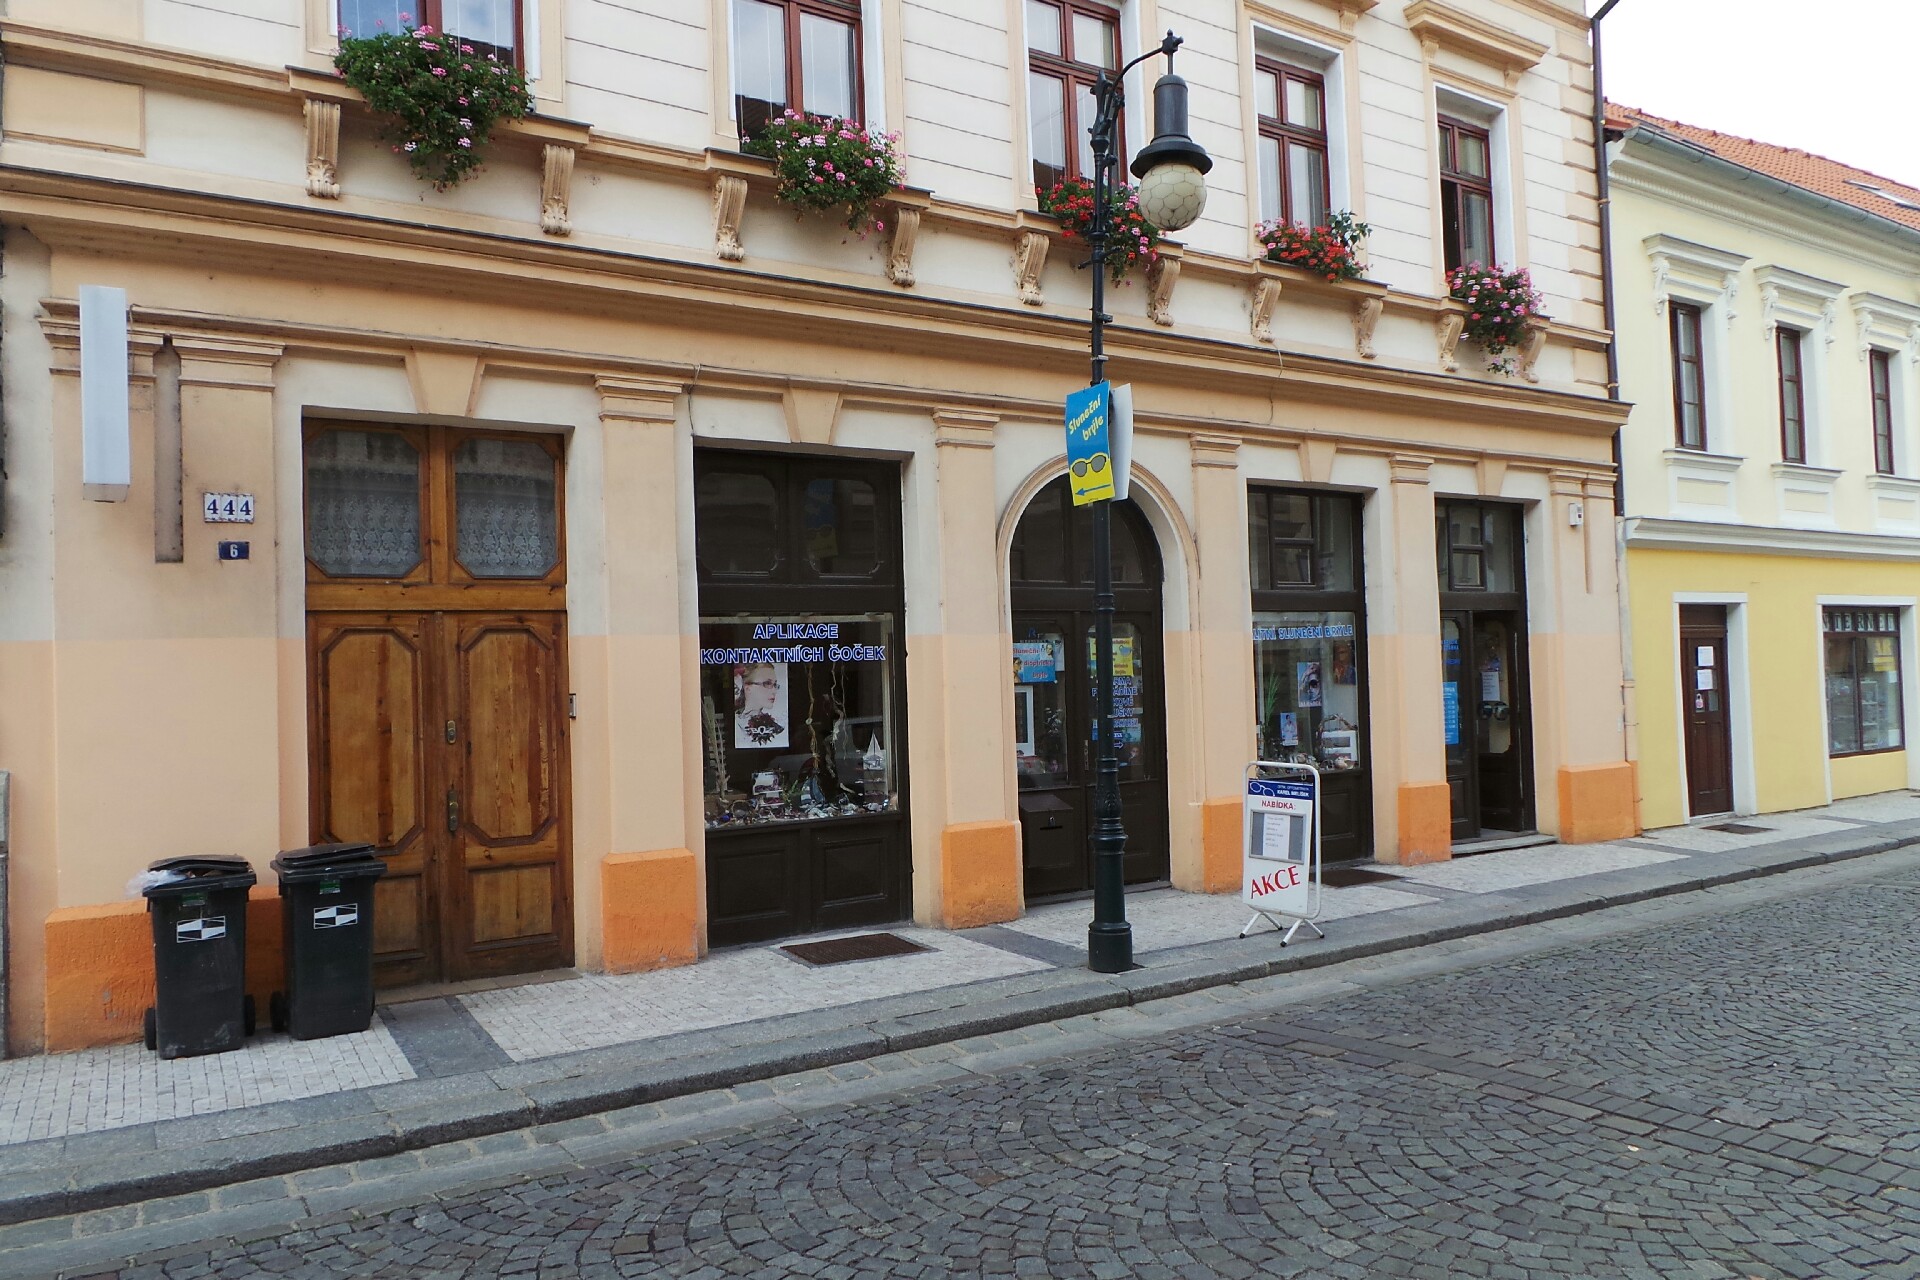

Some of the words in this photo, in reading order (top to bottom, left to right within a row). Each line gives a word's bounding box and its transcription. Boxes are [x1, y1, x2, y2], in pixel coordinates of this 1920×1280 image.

[1068, 393, 1101, 435] Sluneční
[1082, 415, 1104, 441] brýle
[206, 498, 252, 516] 444
[229, 543, 239, 558] 6
[753, 623, 839, 640] APLIKACE
[1278, 623, 1324, 640] SLUNEČNÍ
[1324, 621, 1354, 638] BRÝLE
[700, 644, 825, 665] KONTAKTNÍCH
[828, 643, 887, 662] ČOČEK
[1261, 800, 1296, 810] NABÍDKA:
[1250, 865, 1301, 900] AKCE
